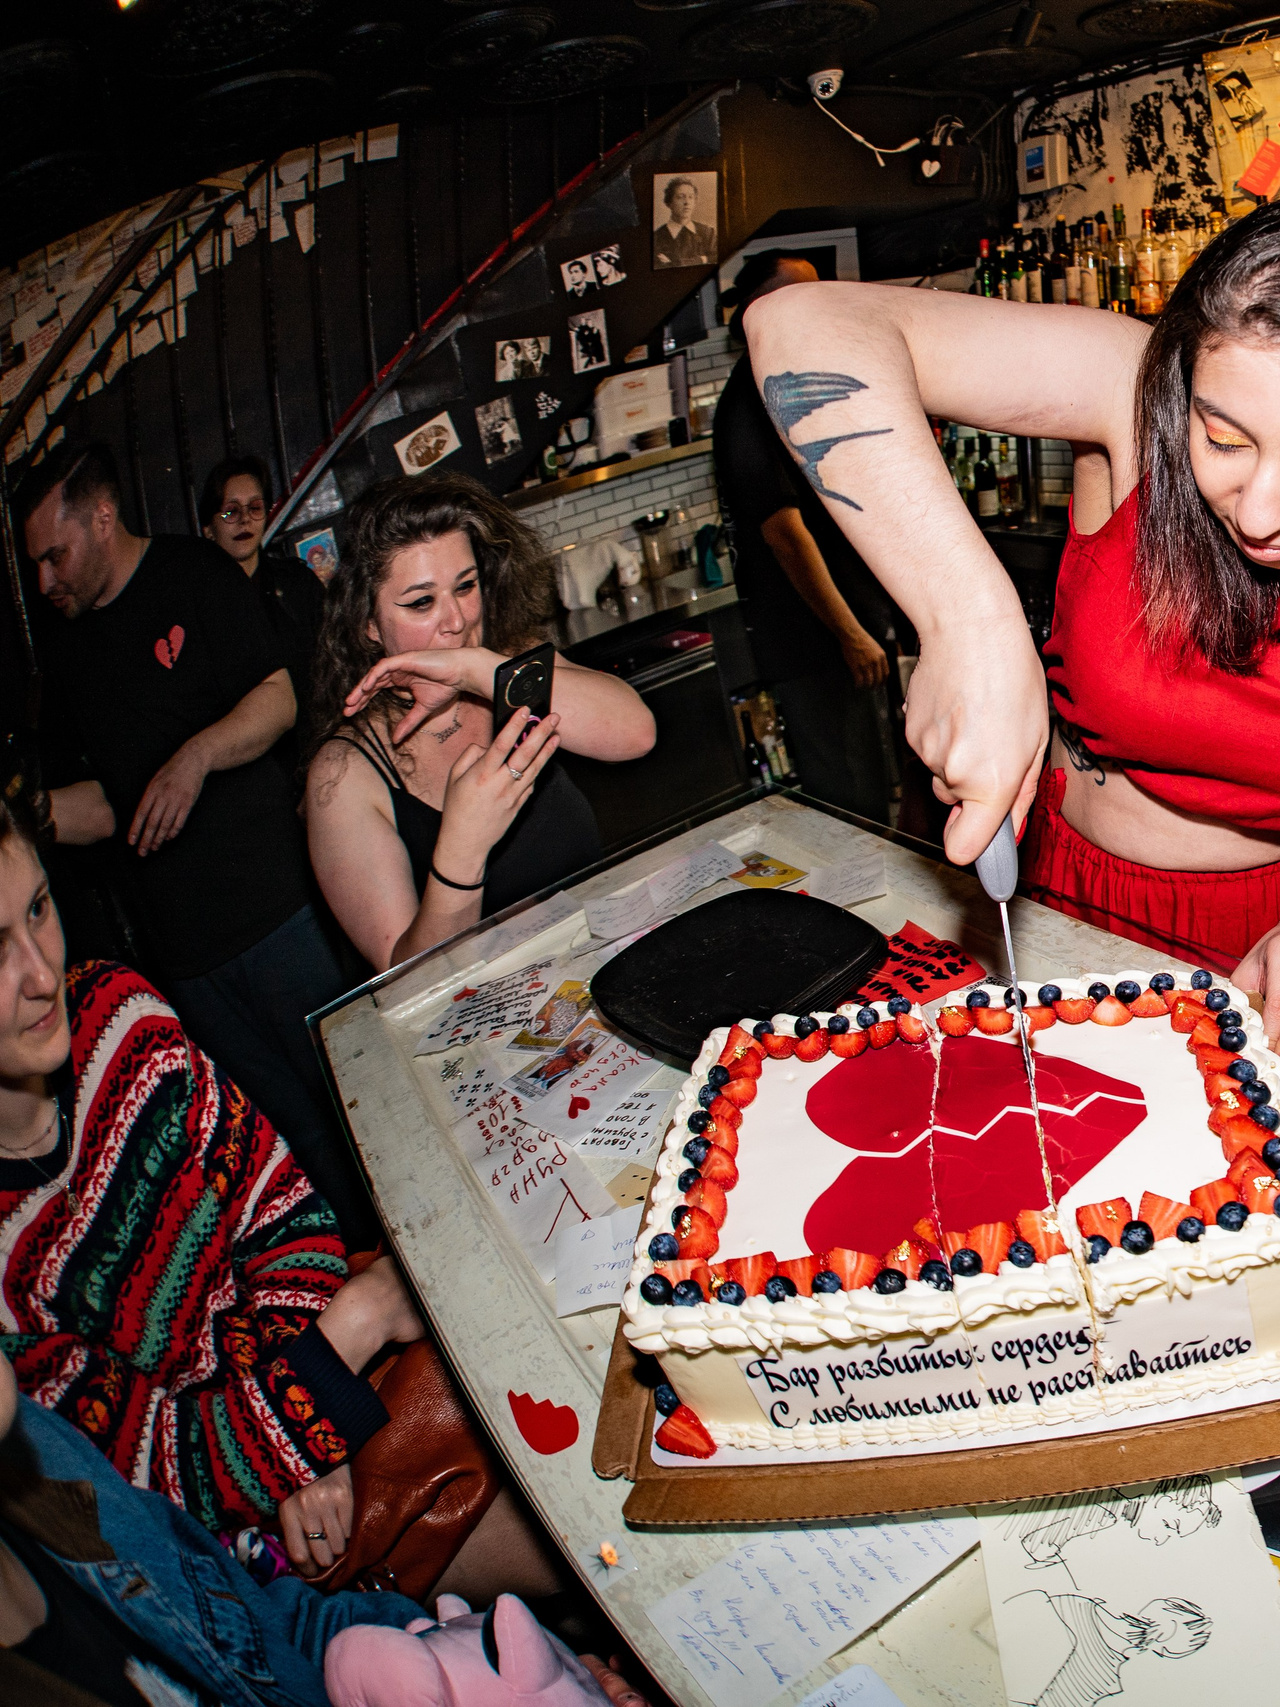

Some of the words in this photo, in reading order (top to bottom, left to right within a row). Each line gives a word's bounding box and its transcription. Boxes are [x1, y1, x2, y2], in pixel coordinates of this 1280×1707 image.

[745, 1357, 821, 1395] Бар
[830, 1333, 984, 1397] разбитых
[768, 1400, 800, 1430] С
[808, 1383, 982, 1428] любимыми
[986, 1384, 1023, 1406] не
